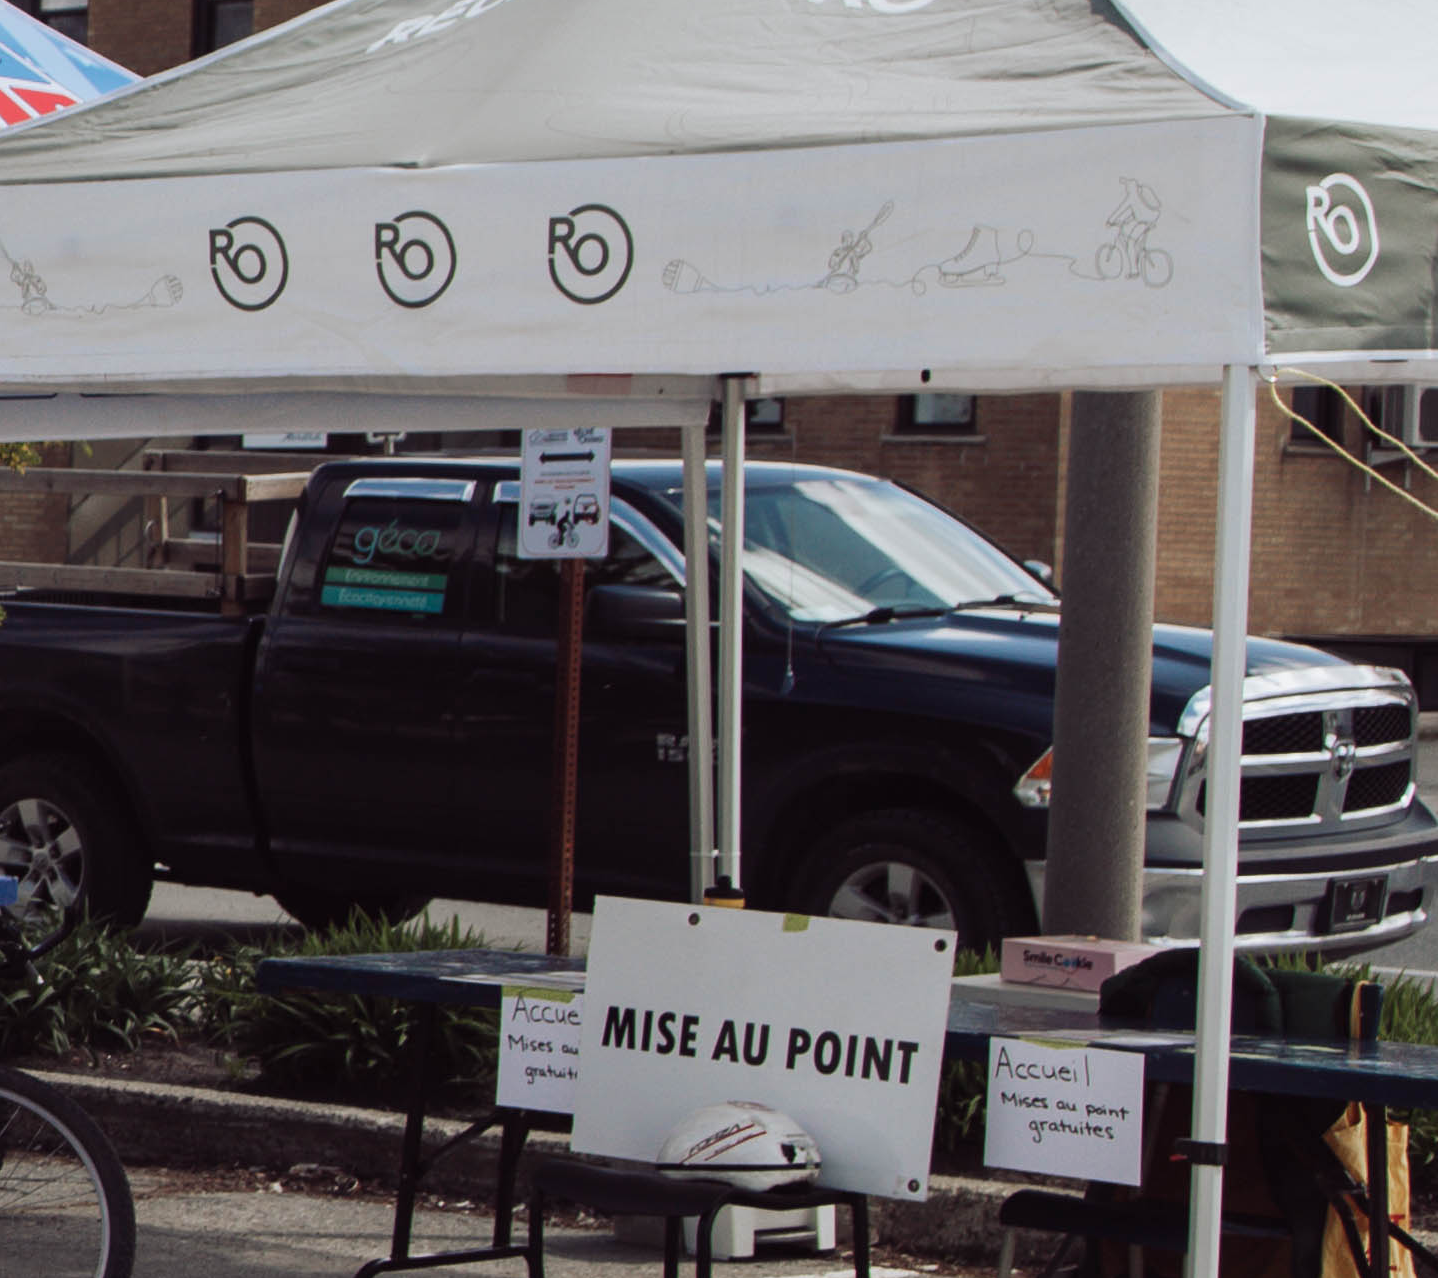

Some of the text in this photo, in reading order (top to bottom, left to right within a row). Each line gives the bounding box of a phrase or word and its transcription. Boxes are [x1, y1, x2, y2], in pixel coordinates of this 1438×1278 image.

[1023, 950, 1053, 965] Smile
[508, 1034, 553, 1053] Mises
[601, 1006, 919, 1084] MISE AU POINT
[995, 1046, 1090, 1087] Accueil
[1000, 1092, 1129, 1121] Mises au point
[1028, 1119, 1114, 1144] gratuites
